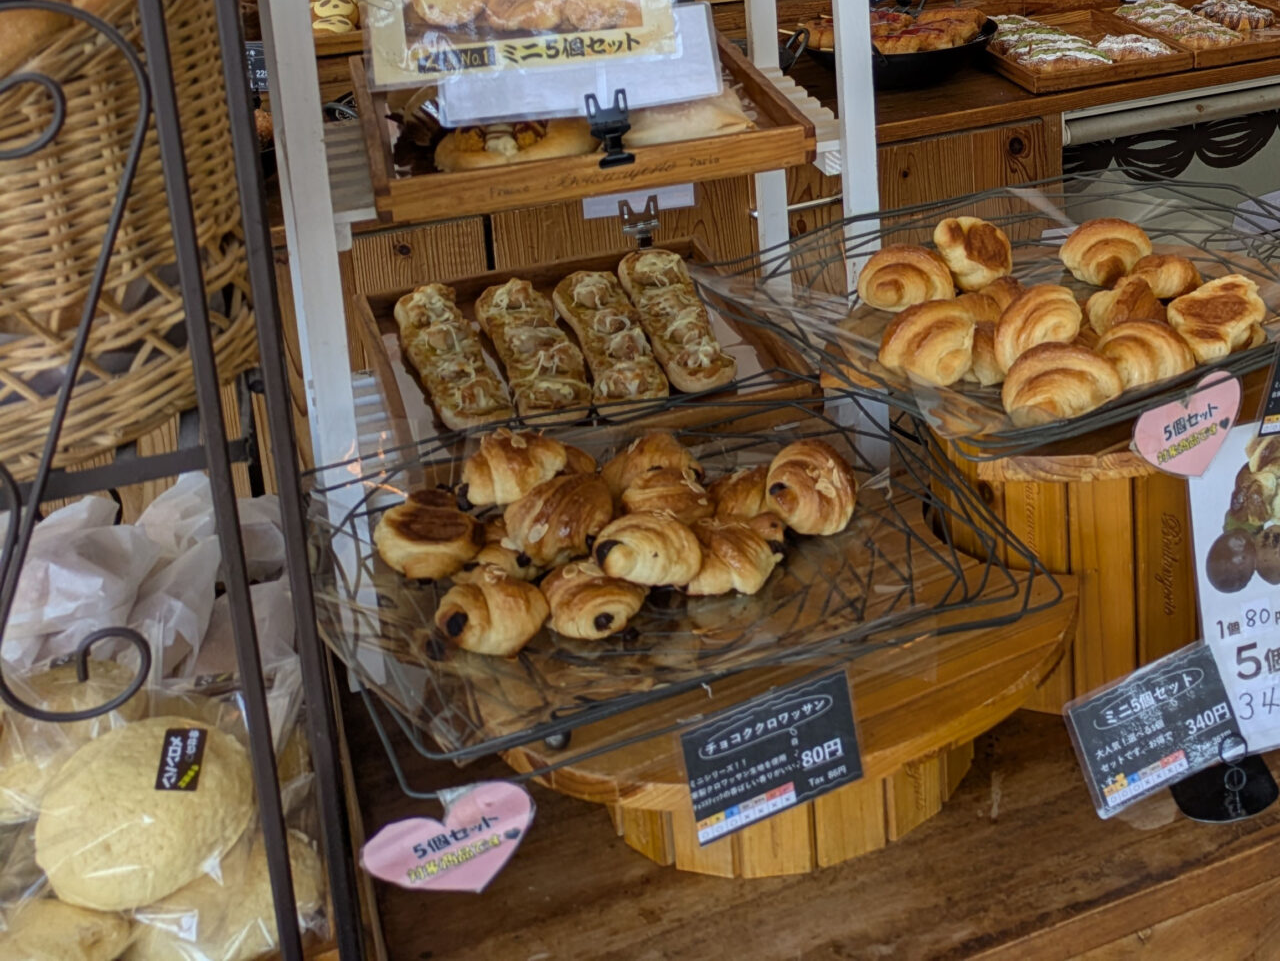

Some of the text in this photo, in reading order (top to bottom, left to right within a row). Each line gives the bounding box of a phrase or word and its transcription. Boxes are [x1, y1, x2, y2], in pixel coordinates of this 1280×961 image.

[503, 32, 641, 64] ミニ5個セット
[1163, 403, 1218, 441] 5個セット
[1216, 619, 1241, 640] 1個
[1104, 673, 1195, 724] ミニ5個セット
[1185, 701, 1232, 735] 340円
[801, 738, 844, 769] 80円
[808, 776, 825, 787] Tax
[412, 816, 499, 859] 5個セット
